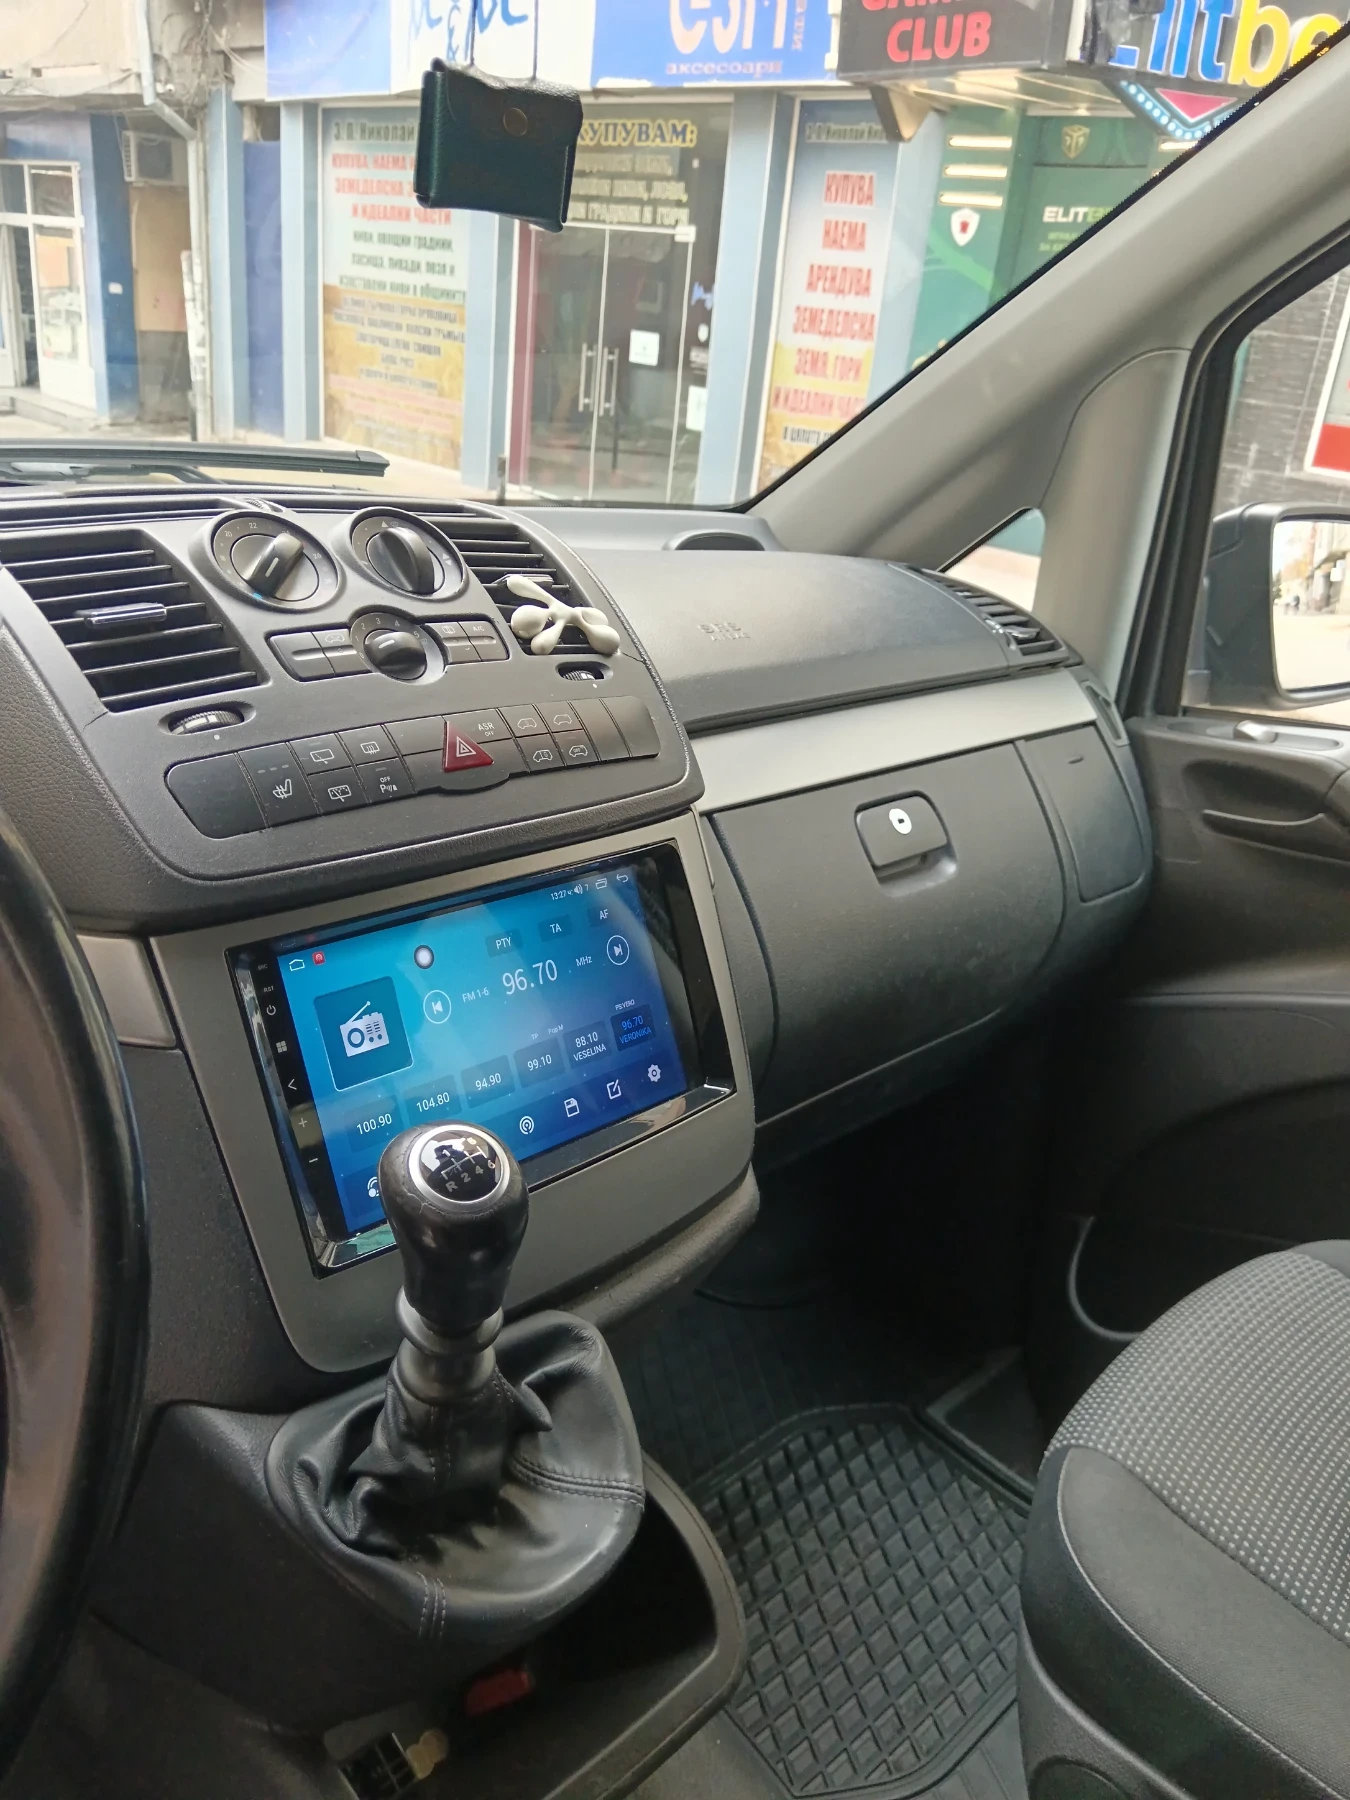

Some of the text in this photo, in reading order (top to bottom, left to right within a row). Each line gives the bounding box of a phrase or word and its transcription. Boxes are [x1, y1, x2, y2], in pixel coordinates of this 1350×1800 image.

[887, 11, 992, 62] CLUB
[666, 60, 783, 79] аксесоари
[824, 172, 875, 206] КУПУВА
[822, 219, 867, 251] НАЕМА
[806, 263, 873, 298] АРЕНДУВА
[793, 305, 875, 341] ЗЕМЕДЕЛСКА
[248, 522, 258, 530] 22
[361, 622, 366, 630] 2
[376, 617, 381, 625] 3
[413, 630, 420, 639] 5
[478, 722, 495, 732] ASR
[551, 890, 567, 900] 13:27
[600, 909, 609, 919] AF
[550, 923, 562, 934] TA
[496, 936, 512, 950] PTY
[502, 955, 593, 995] 96.70 MHz
[462, 987, 489, 1003] FM 1-6
[622, 1015, 644, 1031] 96.70
[575, 1031, 599, 1048] 88.10
[619, 1026, 652, 1044] VERONIKA
[573, 1043, 607, 1062] VESELINA
[527, 1054, 552, 1071] 99.10
[475, 1072, 502, 1091] 94.90
[416, 1092, 450, 1113] 104.80
[356, 1113, 393, 1136] 100.90
[475, 1165, 484, 1174] 4
[487, 1160, 496, 1169] 6
[461, 1172, 471, 1182] 2
[445, 1181, 458, 1193] R
